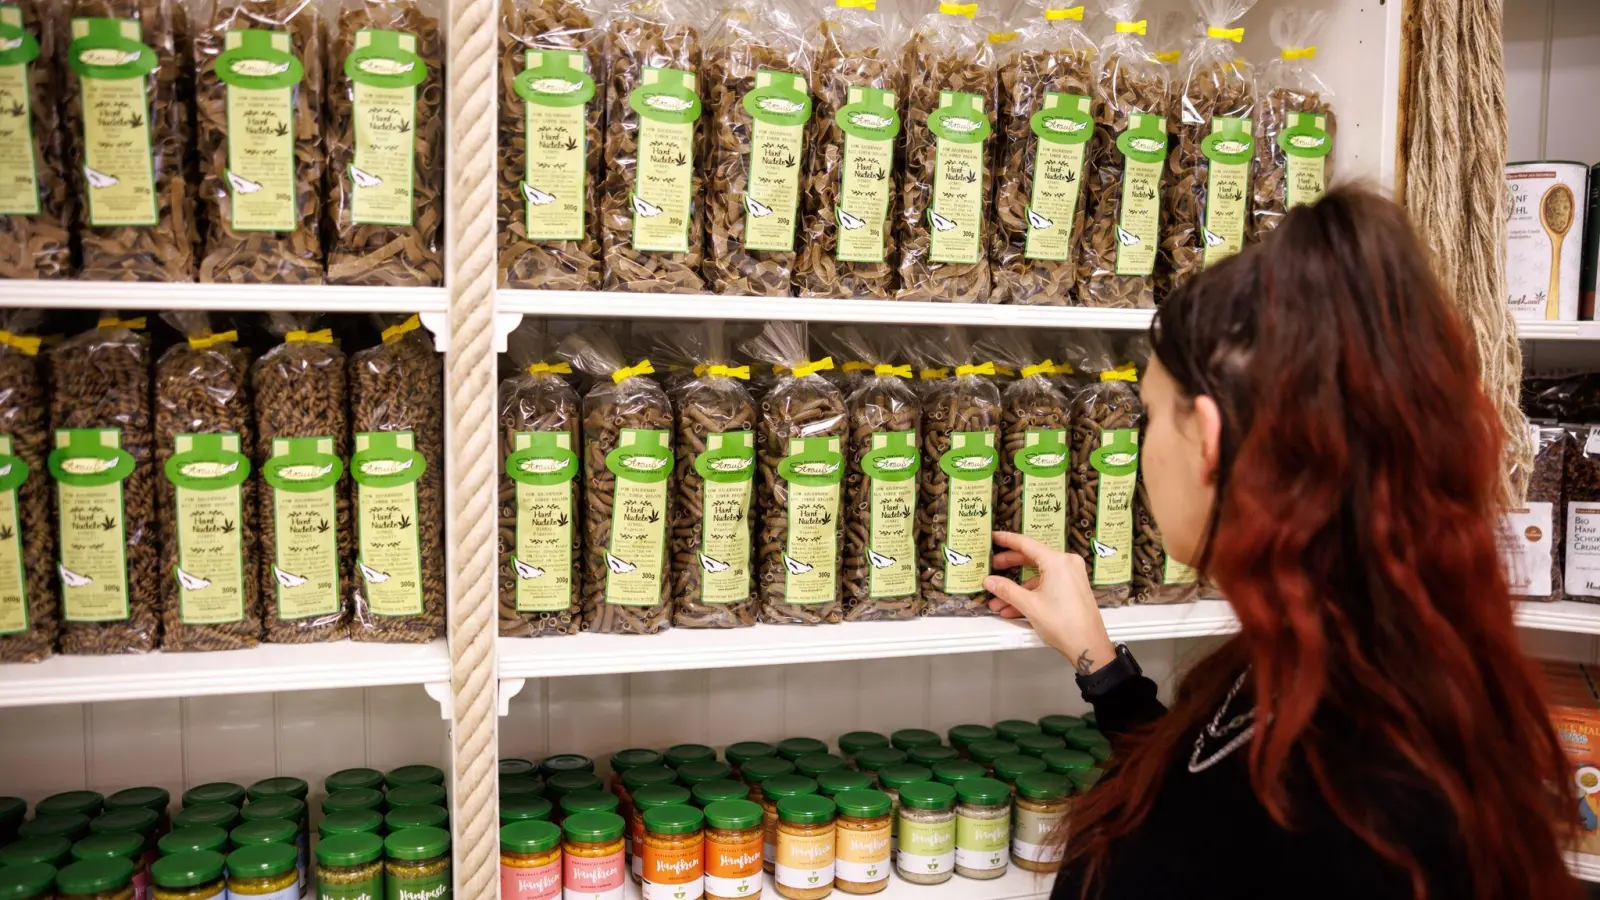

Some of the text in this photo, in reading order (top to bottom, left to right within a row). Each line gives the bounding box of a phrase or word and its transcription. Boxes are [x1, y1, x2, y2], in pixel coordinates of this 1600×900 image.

[539, 141, 565, 149] Nudeln
[650, 155, 676, 164] Nudeln
[763, 156, 786, 166] Nudeln
[854, 170, 877, 179] Nudeln
[946, 173, 967, 181] Nudeln
[1045, 173, 1066, 181] Nudeln
[564, 203, 578, 212] 300g
[669, 218, 682, 226] 300g
[777, 217, 789, 226] 300g
[516, 458, 557, 471] Strauß
[619, 454, 658, 469] Strauß
[707, 457, 744, 470] Strauß
[873, 457, 907, 469] Strauß
[951, 456, 985, 469] Strauß
[790, 462, 828, 474] Strauß
[623, 513, 648, 521] Nudeln
[881, 511, 903, 519] Nudeln
[371, 521, 399, 529] Nudeln
[532, 518, 557, 526] Nudeln
[798, 517, 822, 525] Nudeln
[193, 525, 222, 533] Nudeln
[290, 525, 317, 533] Nudeln
[642, 572, 655, 580] 300g
[818, 571, 830, 579] 300g
[556, 576, 568, 584] 300g
[401, 580, 415, 589] 300g
[656, 858, 699, 874] Hanfkrem
